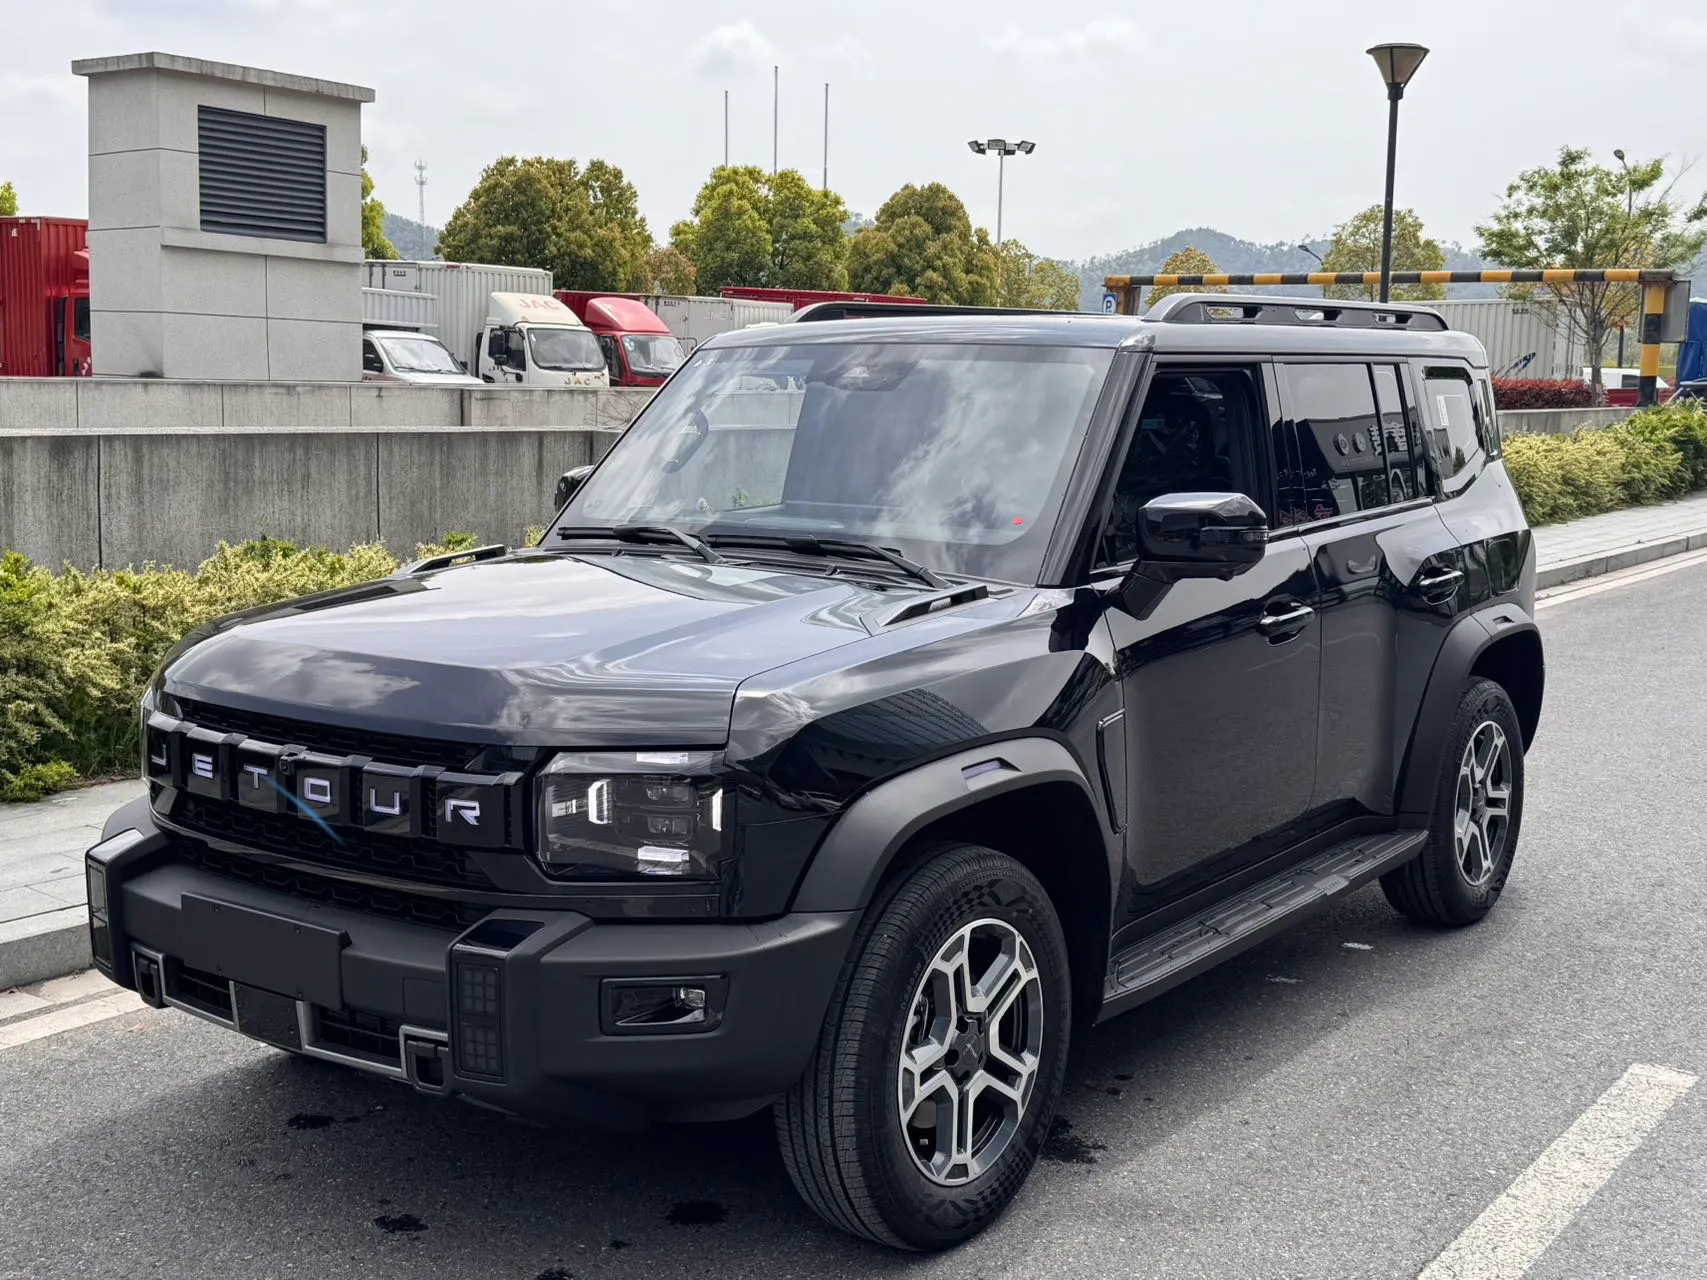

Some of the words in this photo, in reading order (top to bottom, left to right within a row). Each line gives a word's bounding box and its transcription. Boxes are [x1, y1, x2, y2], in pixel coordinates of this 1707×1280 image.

[519, 298, 560, 310] JAC
[564, 377, 591, 386] JAC
[151, 743, 481, 826] JETOUR
